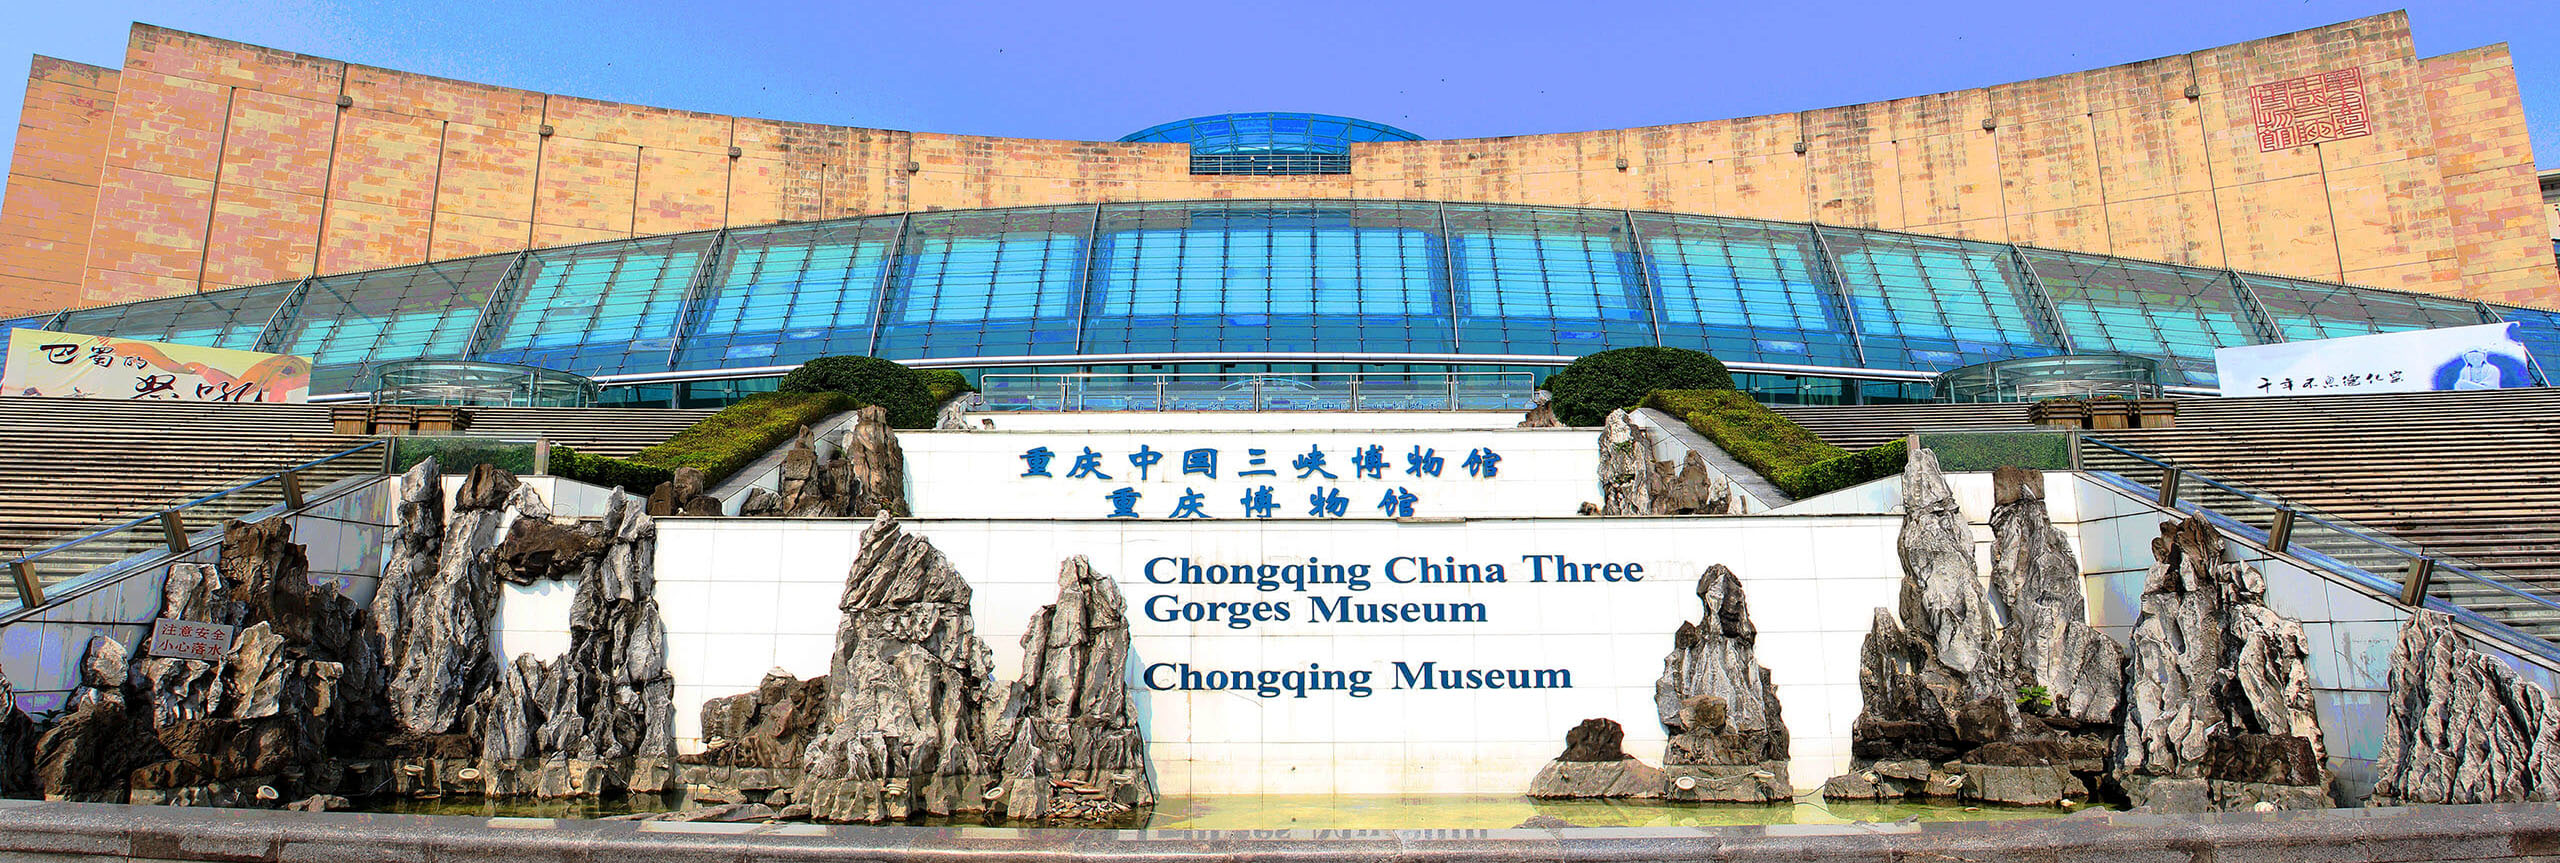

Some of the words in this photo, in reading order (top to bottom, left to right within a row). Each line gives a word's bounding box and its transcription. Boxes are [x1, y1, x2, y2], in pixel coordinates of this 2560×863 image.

[1019, 444, 1501, 480] 重庆中国三峡博物馆
[1105, 486, 1418, 518] 重庆博物馆
[1144, 557, 1371, 592] Chongqing
[1384, 556, 1506, 584] China
[1521, 554, 1644, 583] Three
[1144, 595, 1290, 628] Gorges
[1307, 596, 1488, 623] Museum
[159, 640, 221, 656] 小心落水
[161, 624, 225, 641] 注意安全
[1144, 663, 1373, 698] Chongqing
[1391, 662, 1572, 689] Museum
